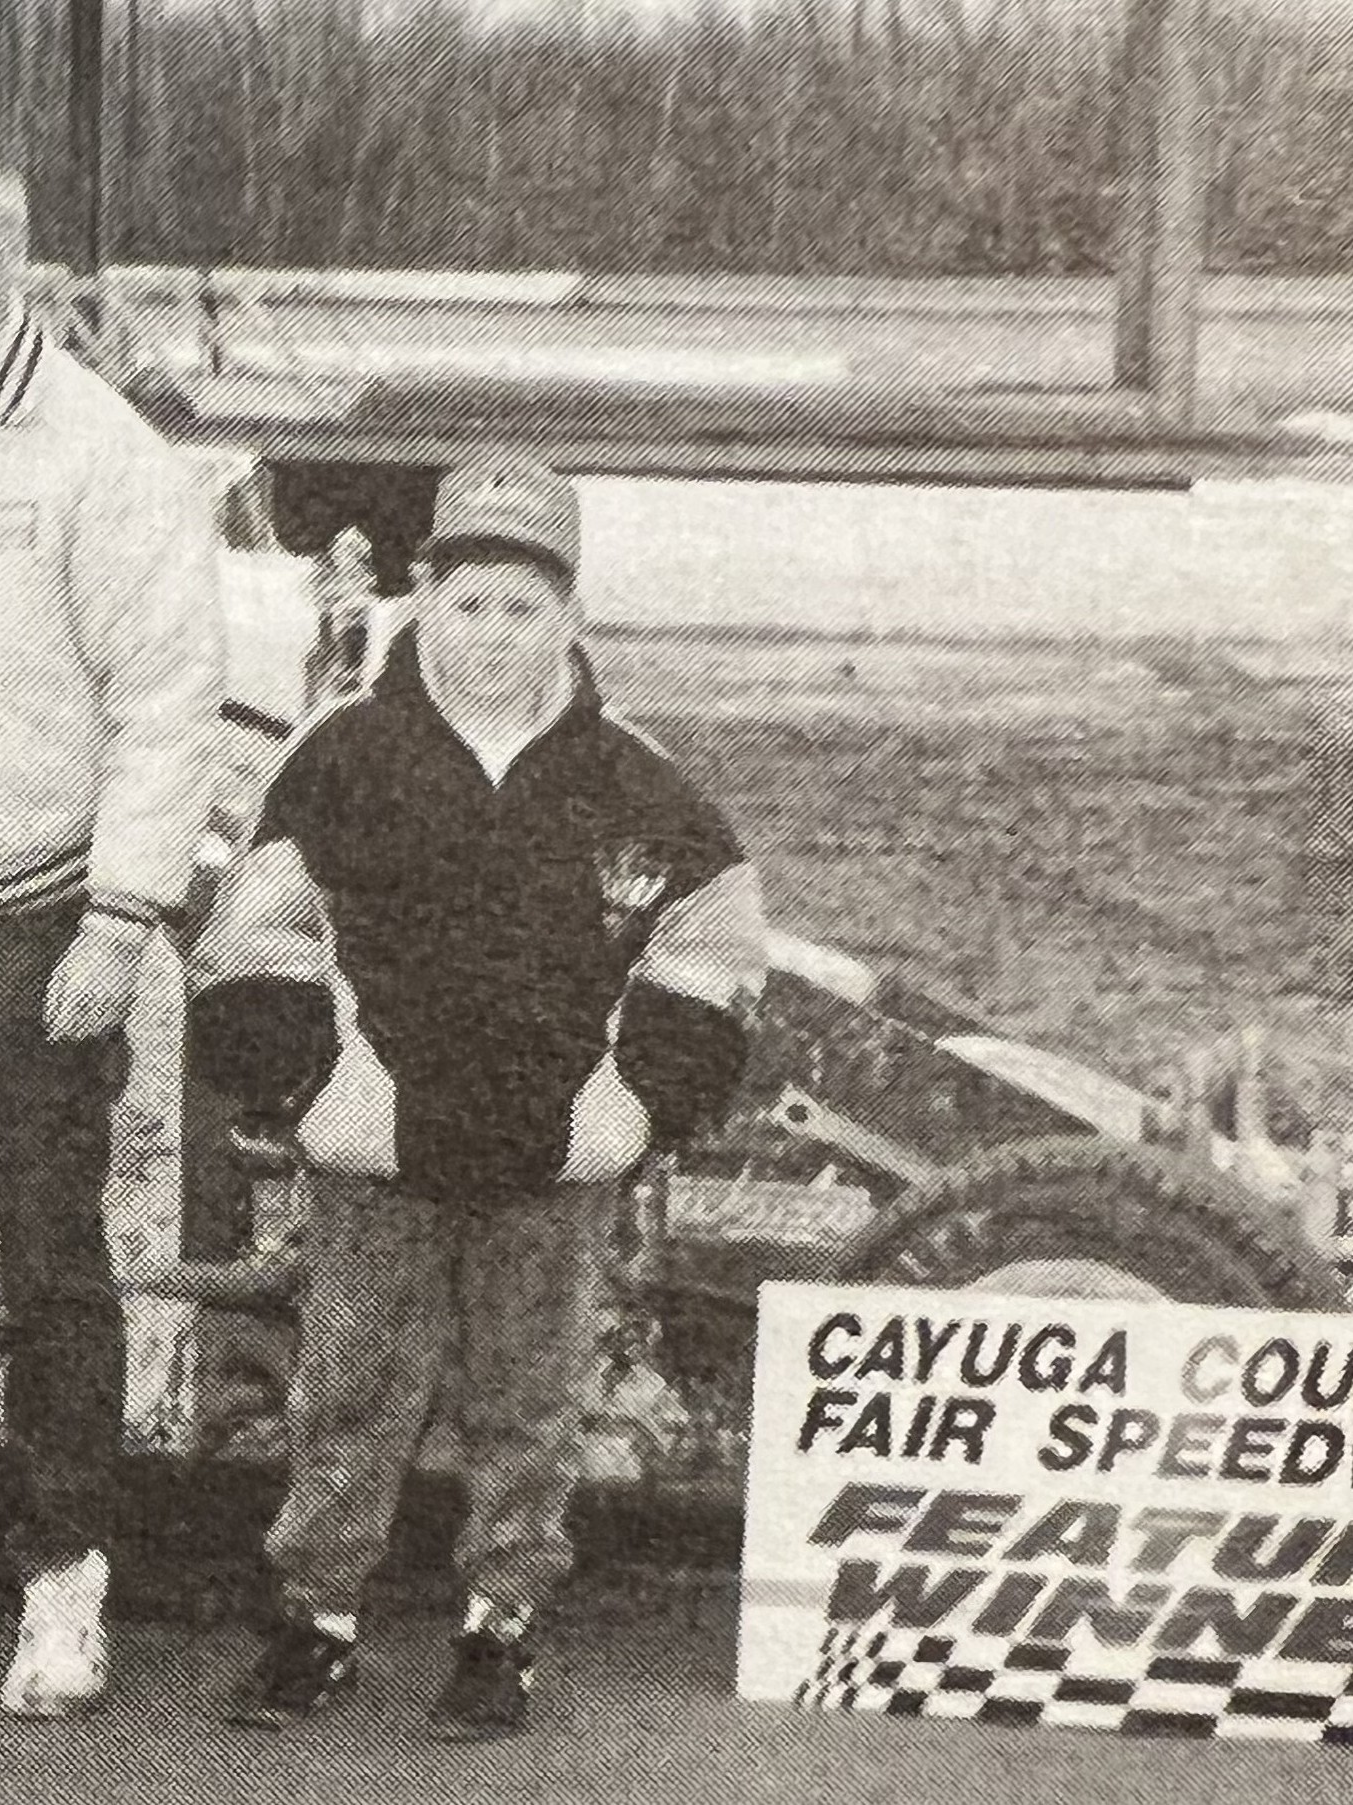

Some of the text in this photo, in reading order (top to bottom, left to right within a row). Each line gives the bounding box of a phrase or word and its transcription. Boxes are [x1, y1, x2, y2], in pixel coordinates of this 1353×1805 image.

[807, 1312, 1353, 1411] CAYUGA COU
[797, 1388, 1353, 1484] FAIR SPEED
